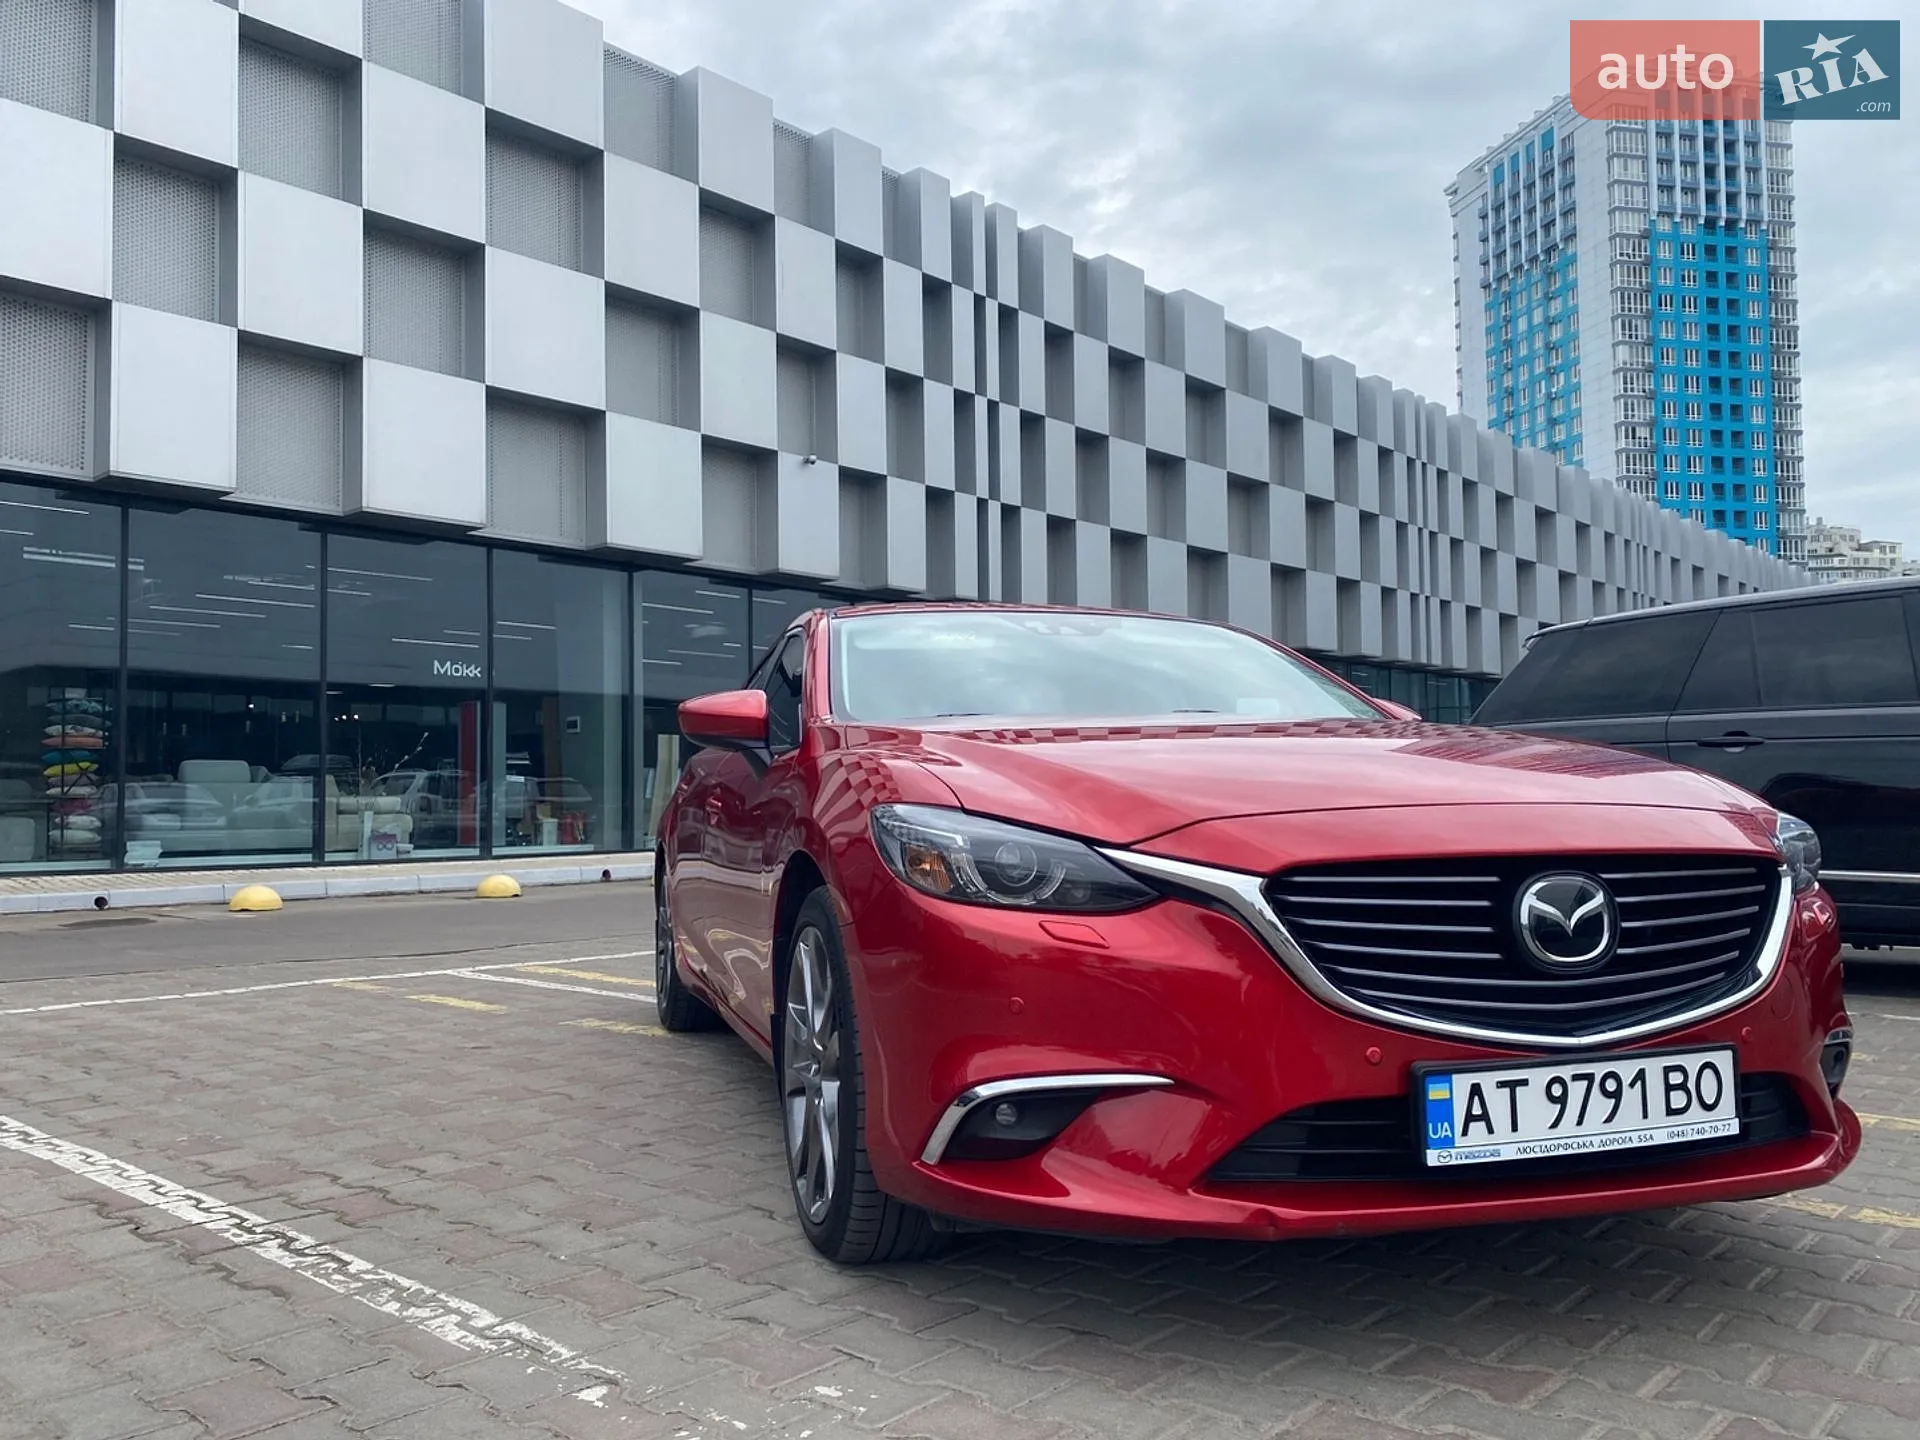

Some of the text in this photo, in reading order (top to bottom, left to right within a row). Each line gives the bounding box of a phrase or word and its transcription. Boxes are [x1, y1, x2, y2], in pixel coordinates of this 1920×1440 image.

[1460, 1061, 1723, 1137] AT 9791 BO
[1428, 1121, 1453, 1139] UA
